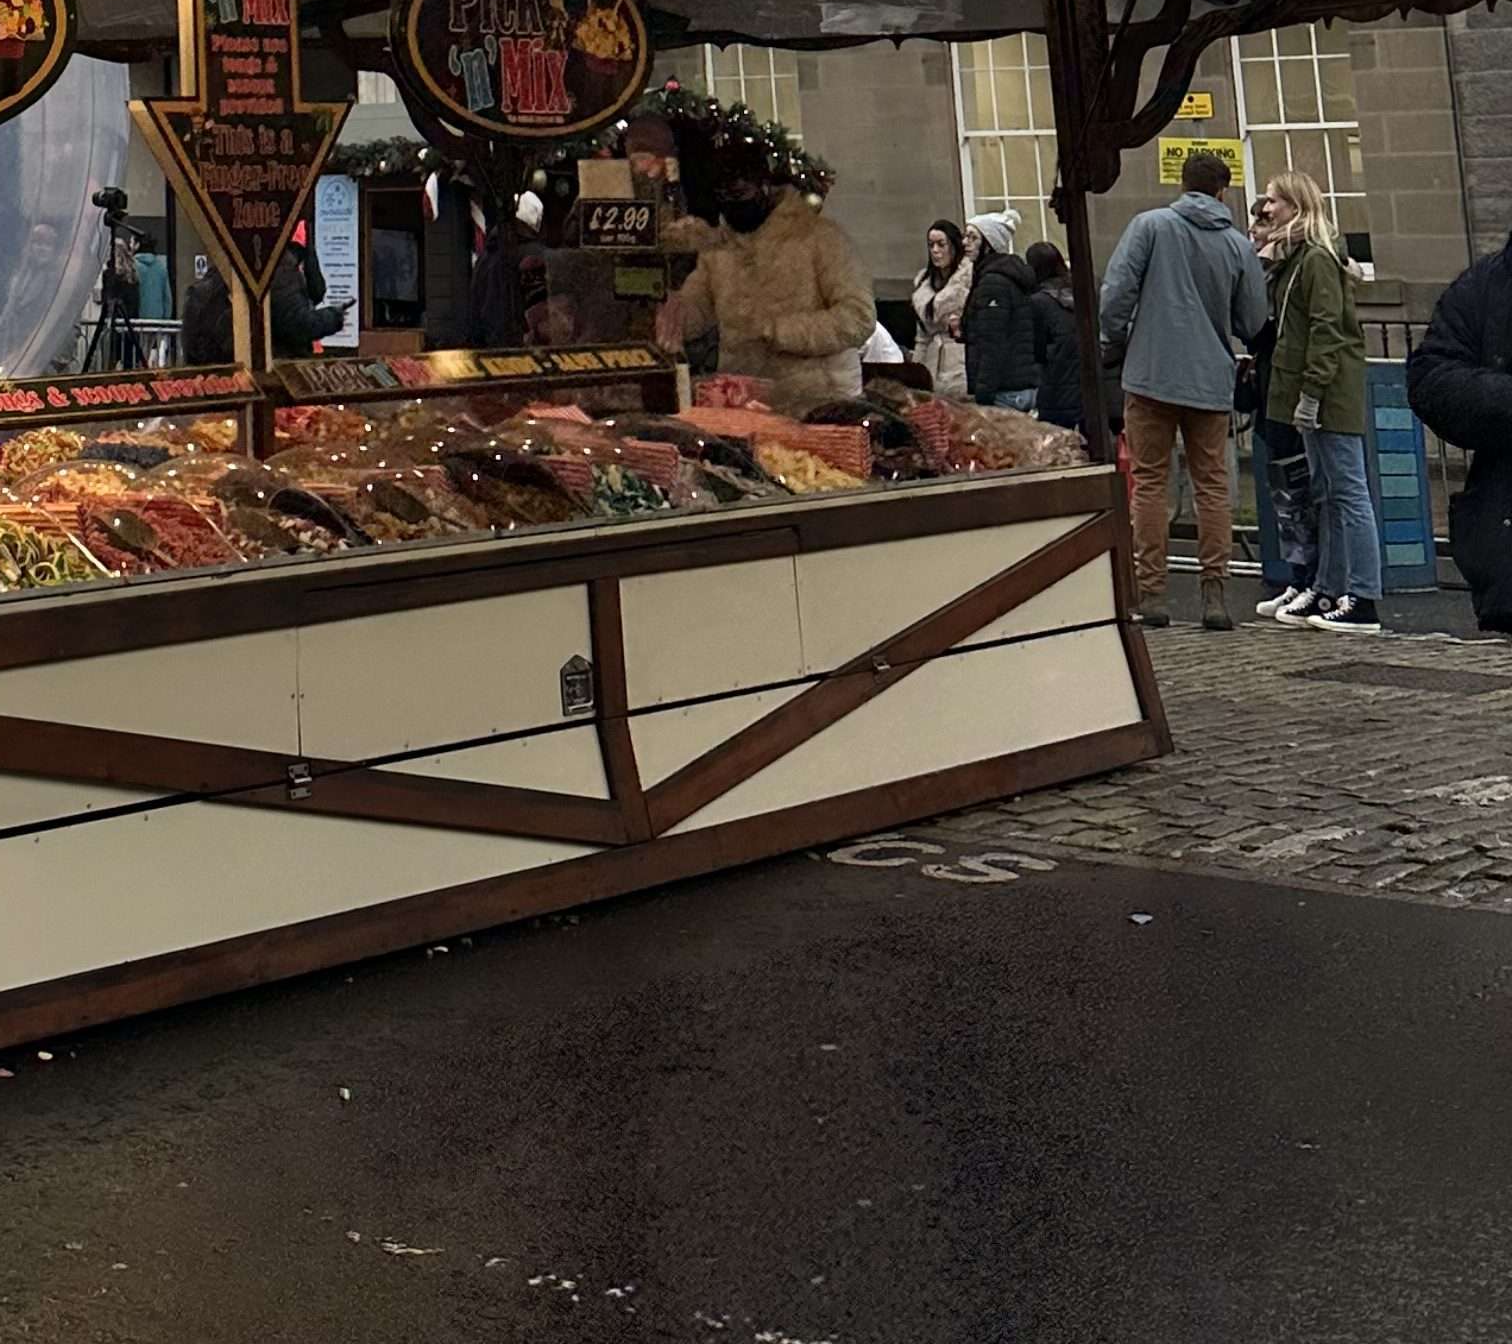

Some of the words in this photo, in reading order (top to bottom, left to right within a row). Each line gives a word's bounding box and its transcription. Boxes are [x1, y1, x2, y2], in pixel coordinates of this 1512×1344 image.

[498, 35, 571, 114] Mix
[212, 123, 256, 156] This
[258, 124, 276, 155] is
[1166, 147, 1184, 158] NO
[232, 198, 281, 229] Zone
[589, 206, 650, 231] £2.99
[46, 385, 72, 409] &
[70, 382, 152, 405] scoops
[148, 368, 256, 402] provided
